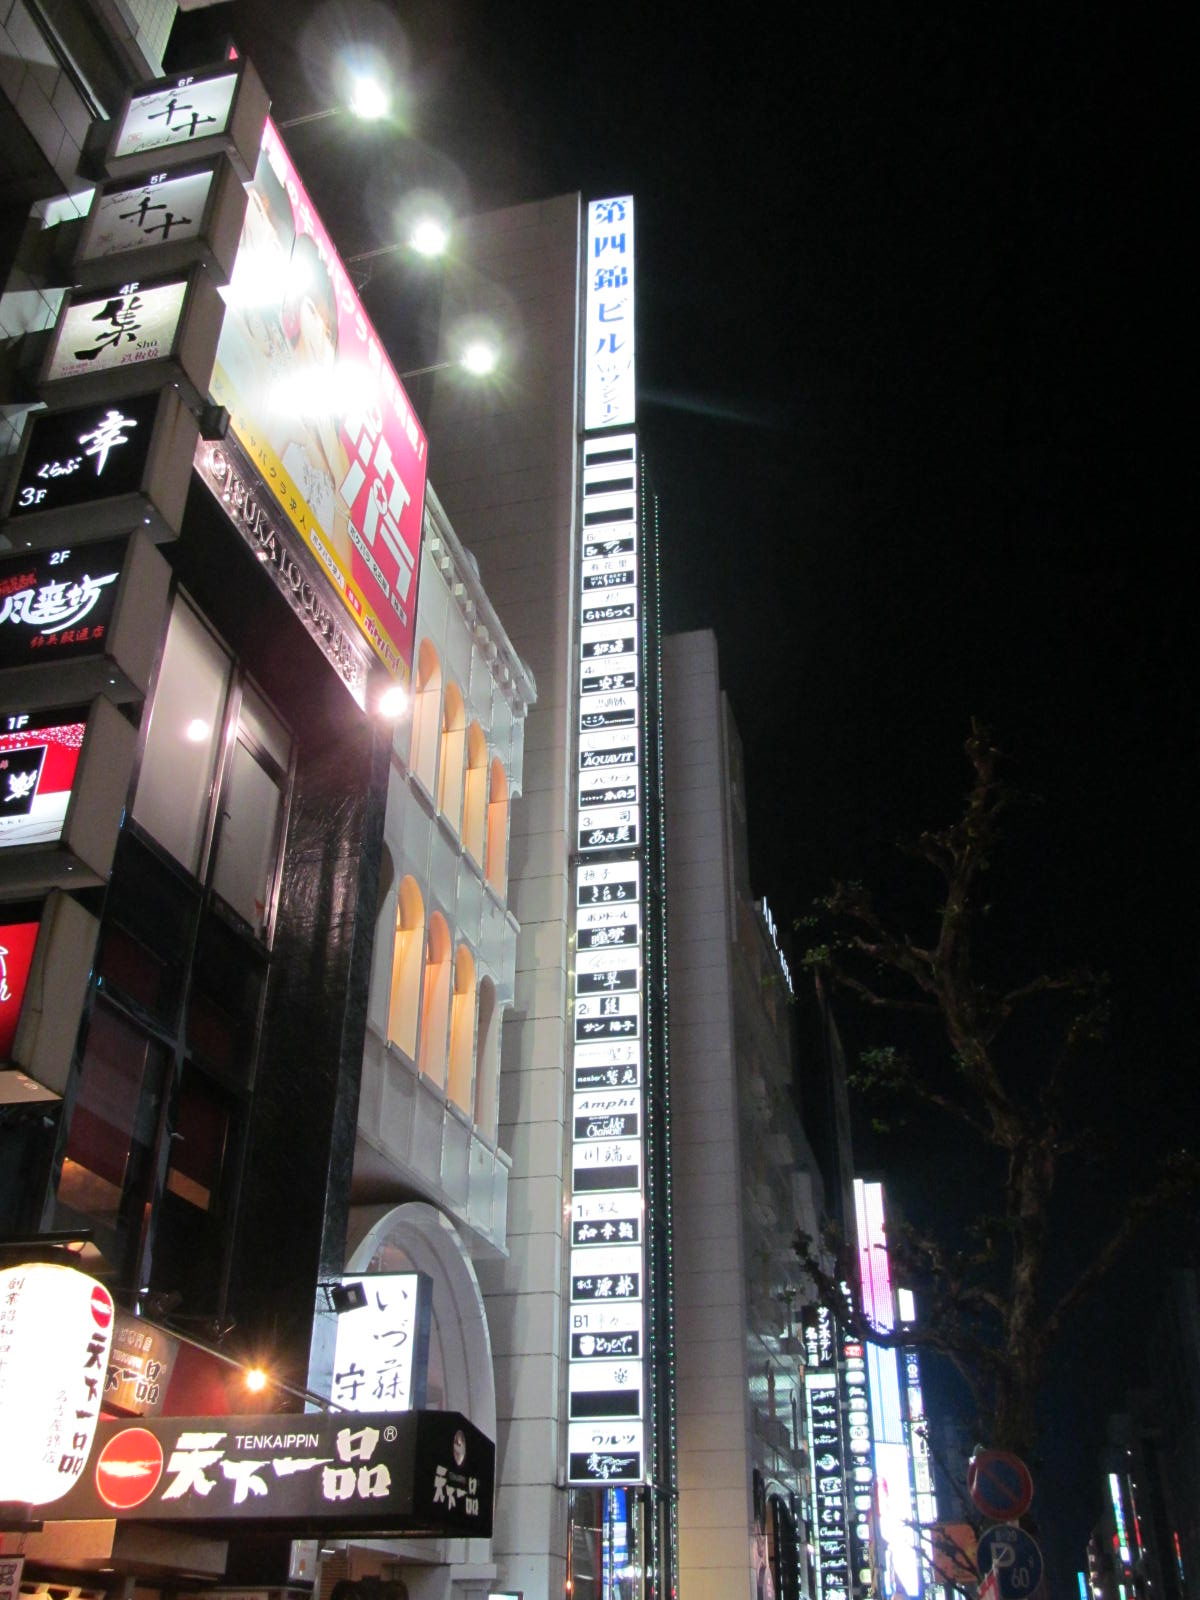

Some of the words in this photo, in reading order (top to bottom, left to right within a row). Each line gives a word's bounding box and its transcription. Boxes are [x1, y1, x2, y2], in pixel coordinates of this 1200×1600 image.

[178, 77, 194, 88] 6F
[150, 173, 168, 185] 5F
[593, 200, 629, 355] 第四錦ビル
[120, 283, 140, 295] 4F
[79, 411, 138, 477] 幸
[19, 487, 48, 507] 3F
[49, 550, 71, 565] 2F
[8, 715, 30, 730] 1F
[58, 1333, 107, 1478] 天下一品
[235, 1433, 320, 1450] TENKAIPPIN
[161, 1427, 392, 1504] 天下一品
